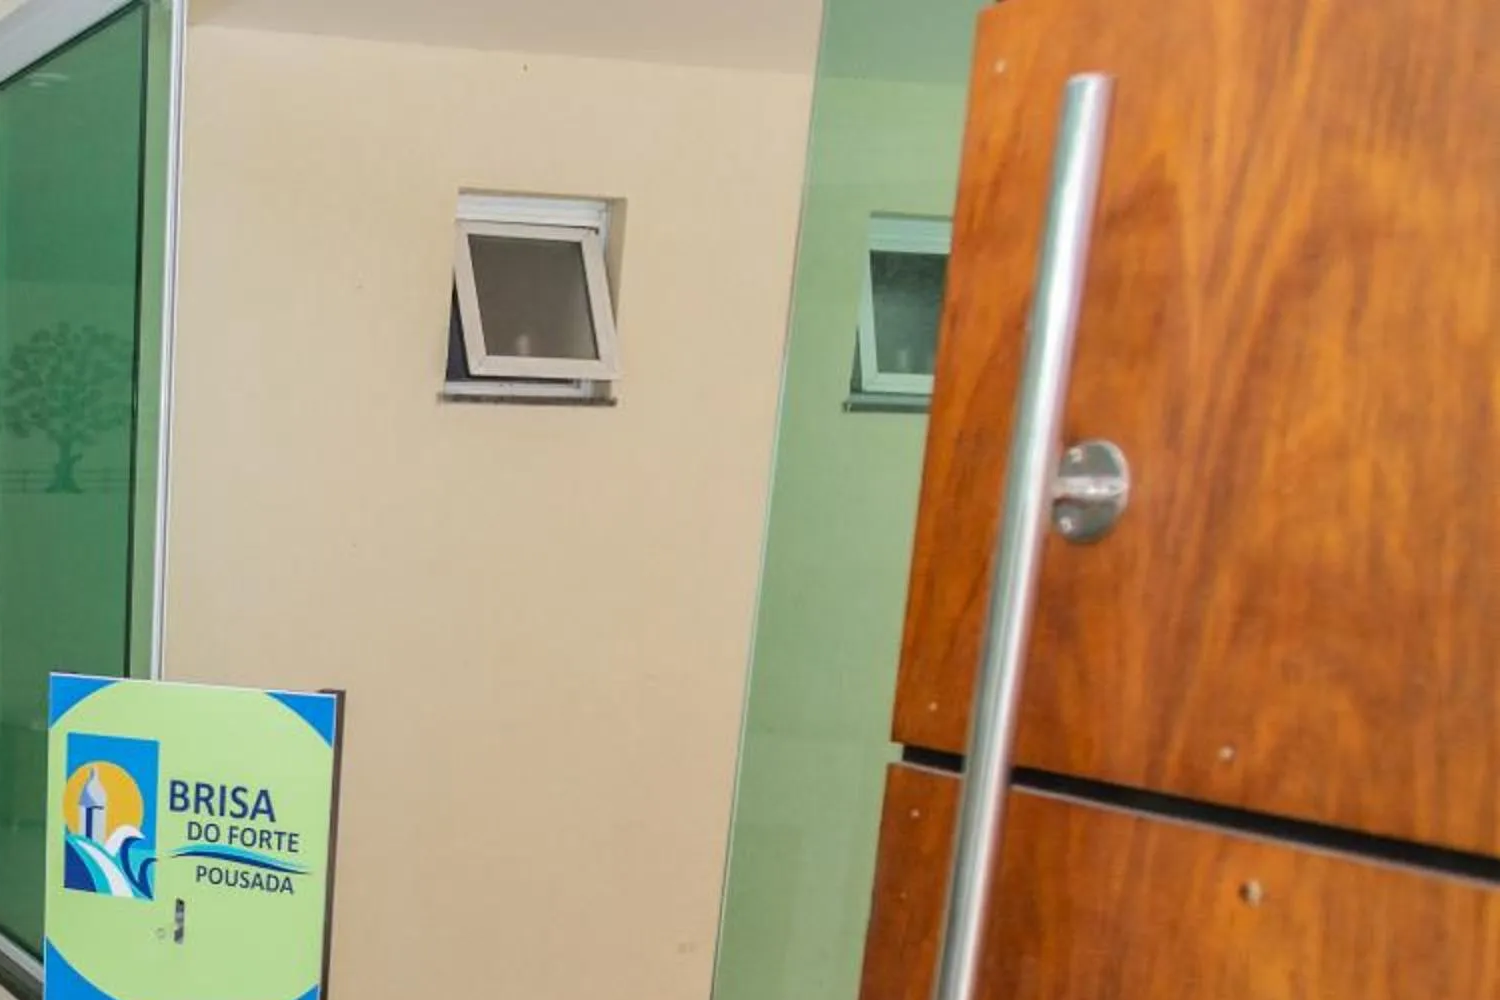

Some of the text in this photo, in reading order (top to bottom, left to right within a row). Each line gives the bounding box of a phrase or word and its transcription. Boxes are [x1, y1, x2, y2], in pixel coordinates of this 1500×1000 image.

[169, 779, 277, 823] BRISA
[187, 821, 301, 853] DO FORTE
[195, 865, 295, 896] POUSADA
